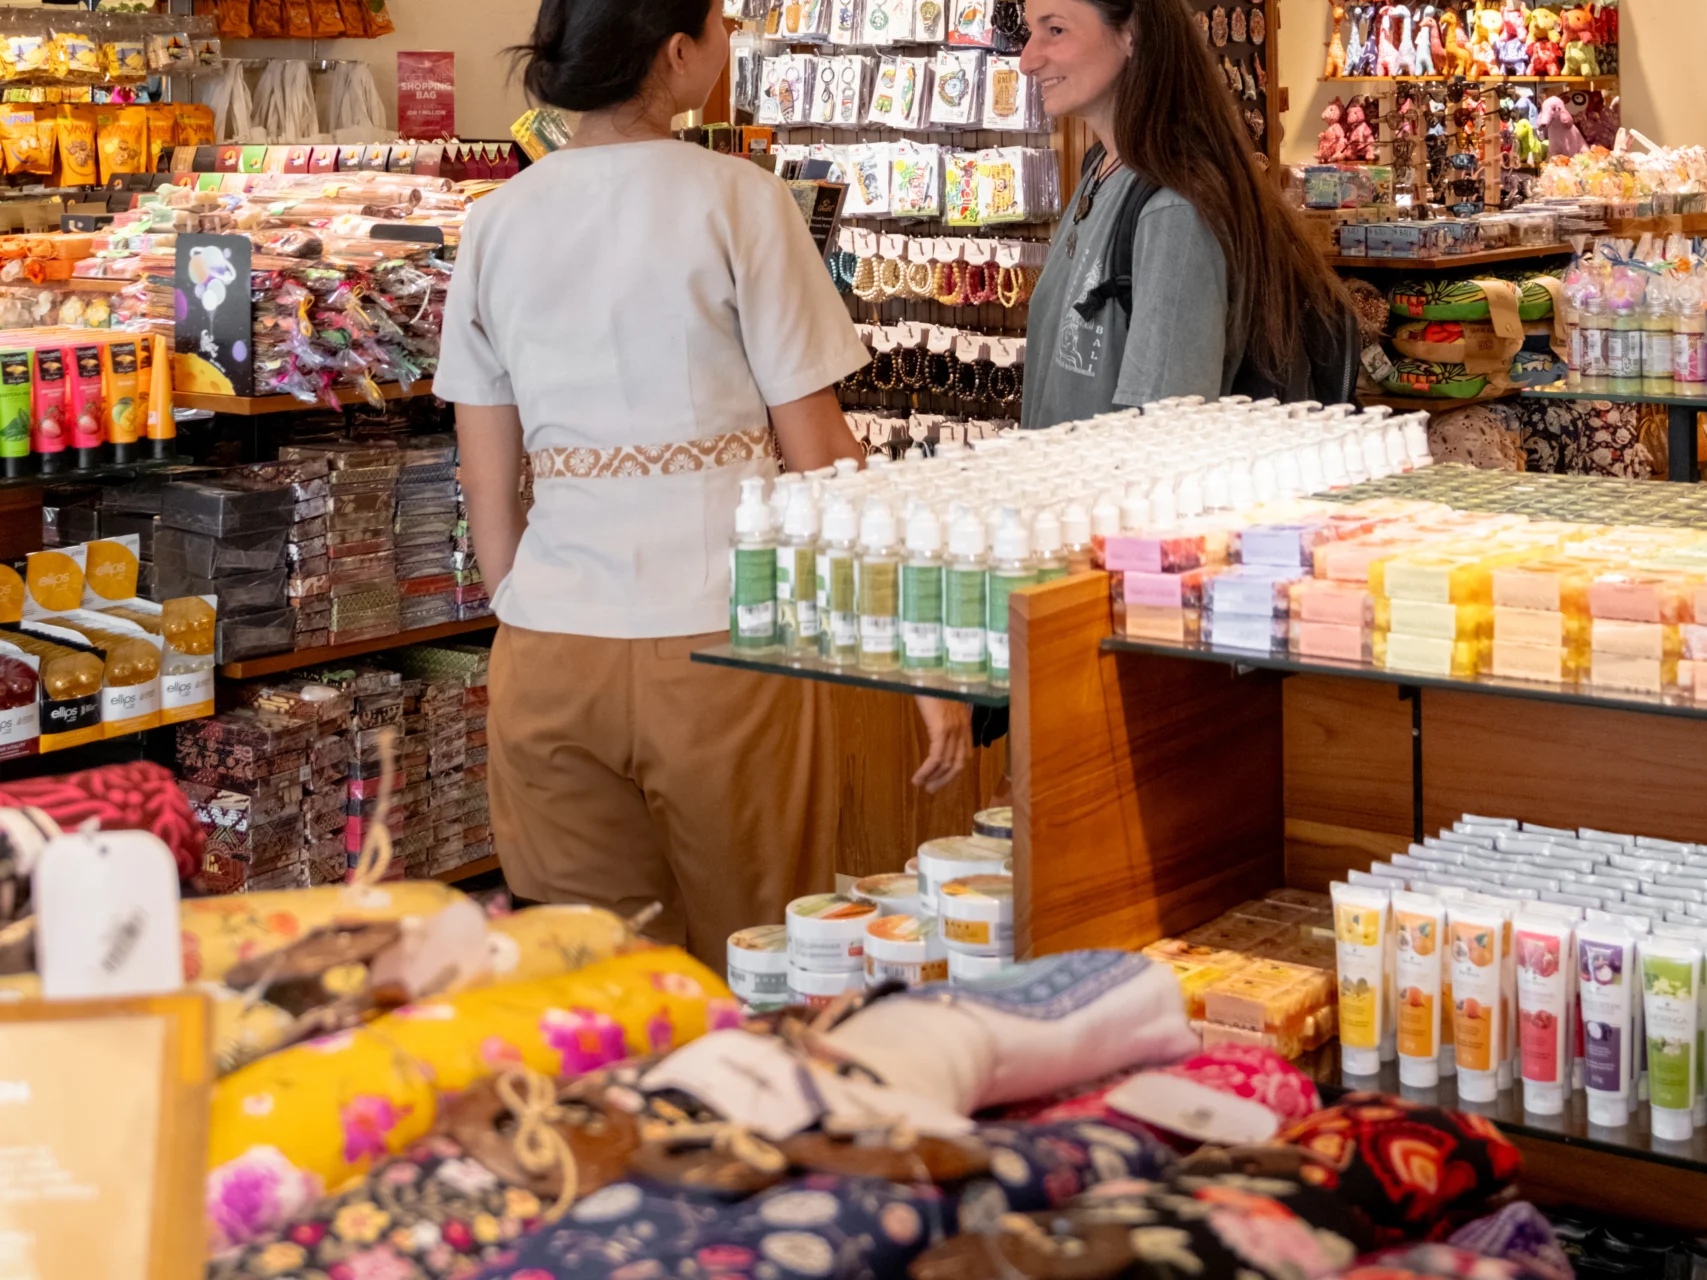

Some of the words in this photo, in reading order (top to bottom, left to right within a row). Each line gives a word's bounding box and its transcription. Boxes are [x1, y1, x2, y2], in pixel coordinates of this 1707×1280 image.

[400, 82, 451, 91] SHOPPING
[416, 91, 437, 99] BAG
[1087, 325, 1104, 373] BALI
[96, 561, 126, 577] ellips
[38, 573, 70, 588] ellips
[166, 681, 192, 695] ellips
[110, 692, 137, 707] ellips
[51, 705, 78, 721] ellips
